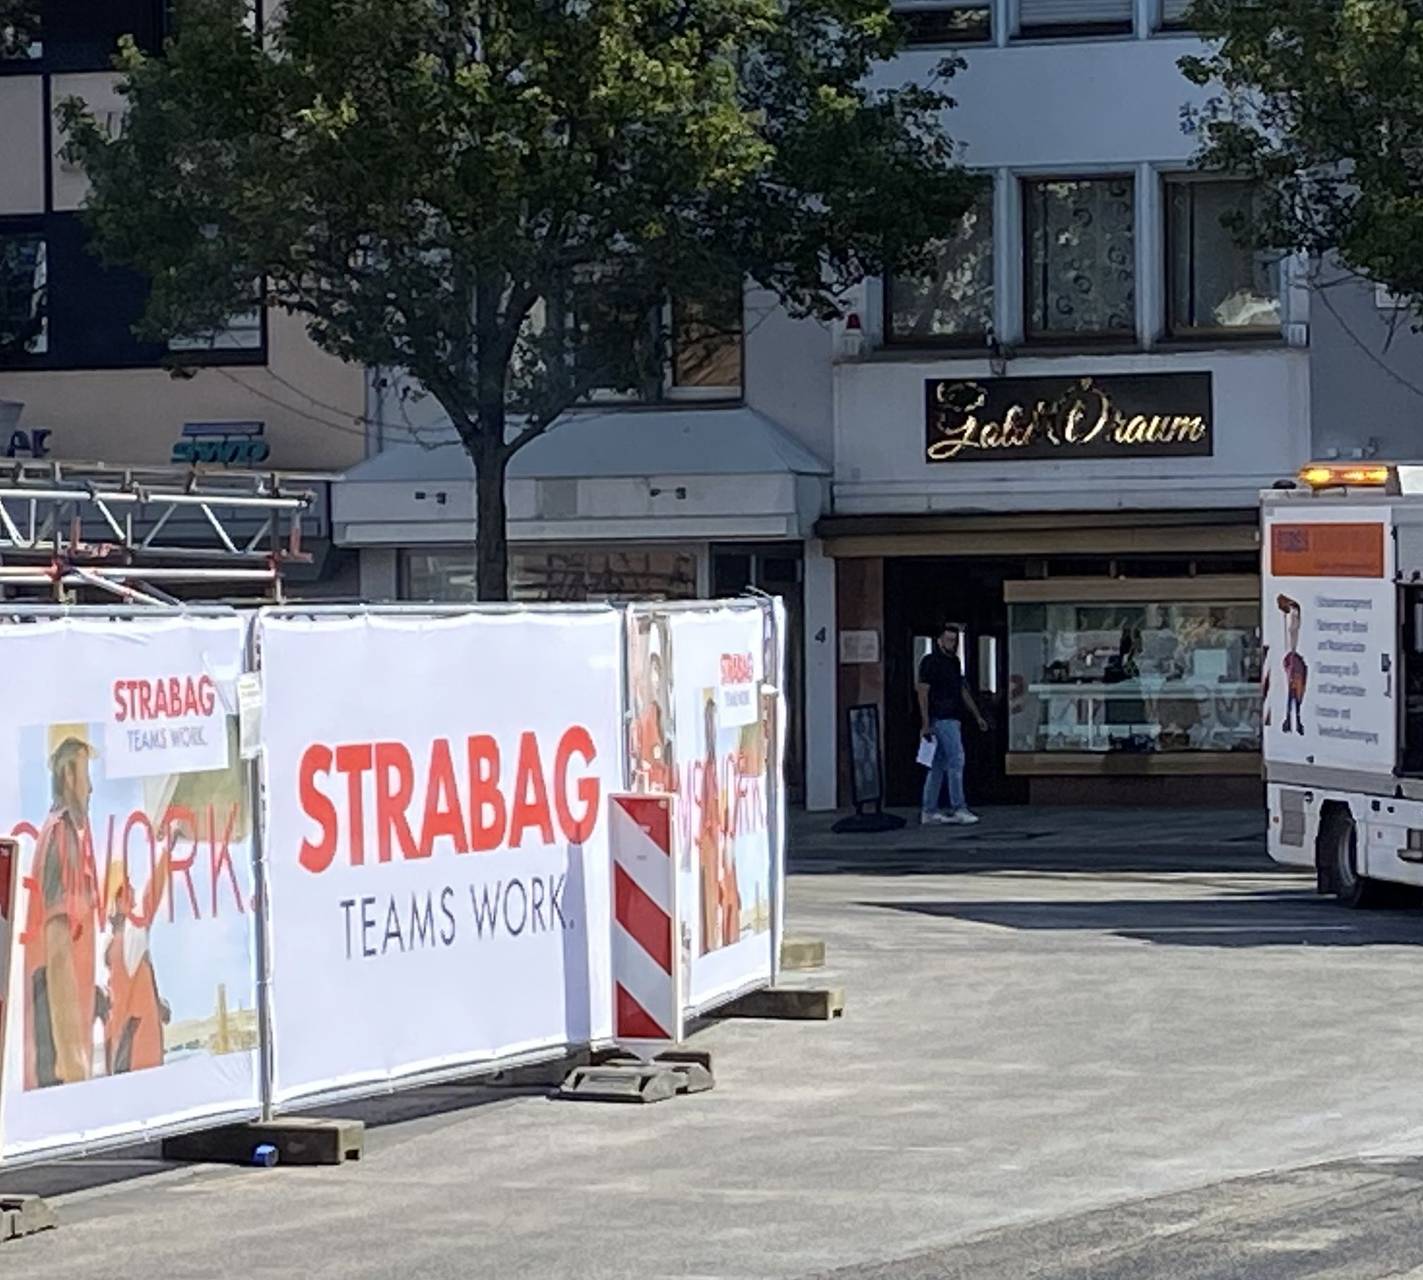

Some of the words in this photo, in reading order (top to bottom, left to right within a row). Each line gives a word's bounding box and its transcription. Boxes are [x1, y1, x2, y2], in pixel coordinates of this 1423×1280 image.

[814, 626, 827, 643] 4
[112, 675, 216, 722] STRABAG
[126, 728, 168, 752] TEAMS
[298, 725, 600, 874] STRABAG
[339, 886, 456, 960] TEAMS
[469, 873, 576, 939] WORK.
